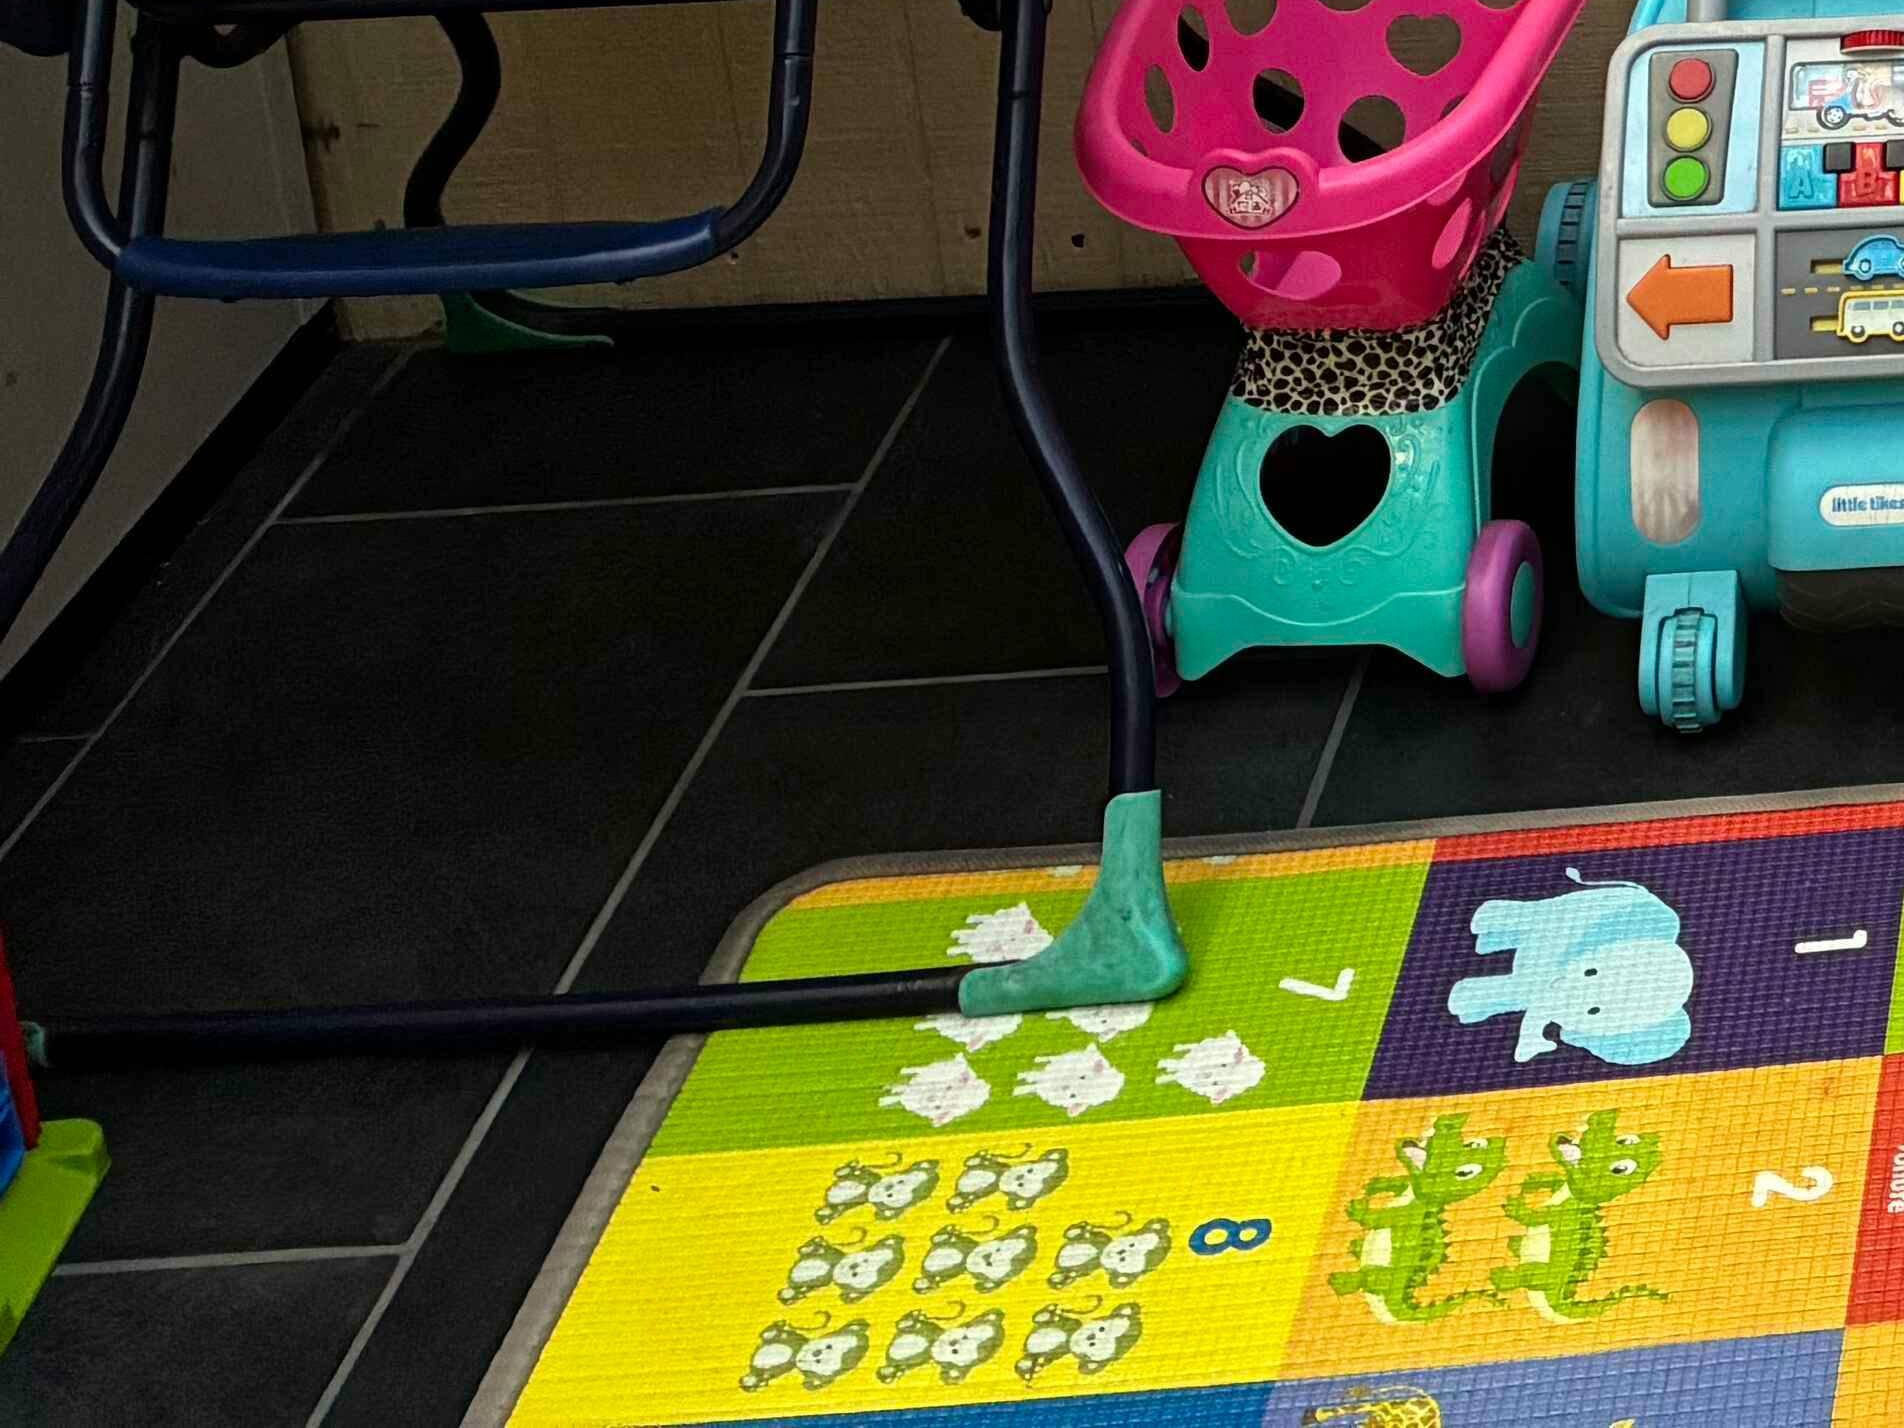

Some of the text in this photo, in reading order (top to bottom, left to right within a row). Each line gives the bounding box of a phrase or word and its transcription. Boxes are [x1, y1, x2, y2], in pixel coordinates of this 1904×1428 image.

[1787, 168, 1815, 199] A
[1855, 167, 1879, 195] B
[1795, 929, 1868, 954] 1
[1279, 968, 1355, 1001] 7
[1752, 1165, 1834, 1209] 2
[1189, 1217, 1273, 1257] 8
